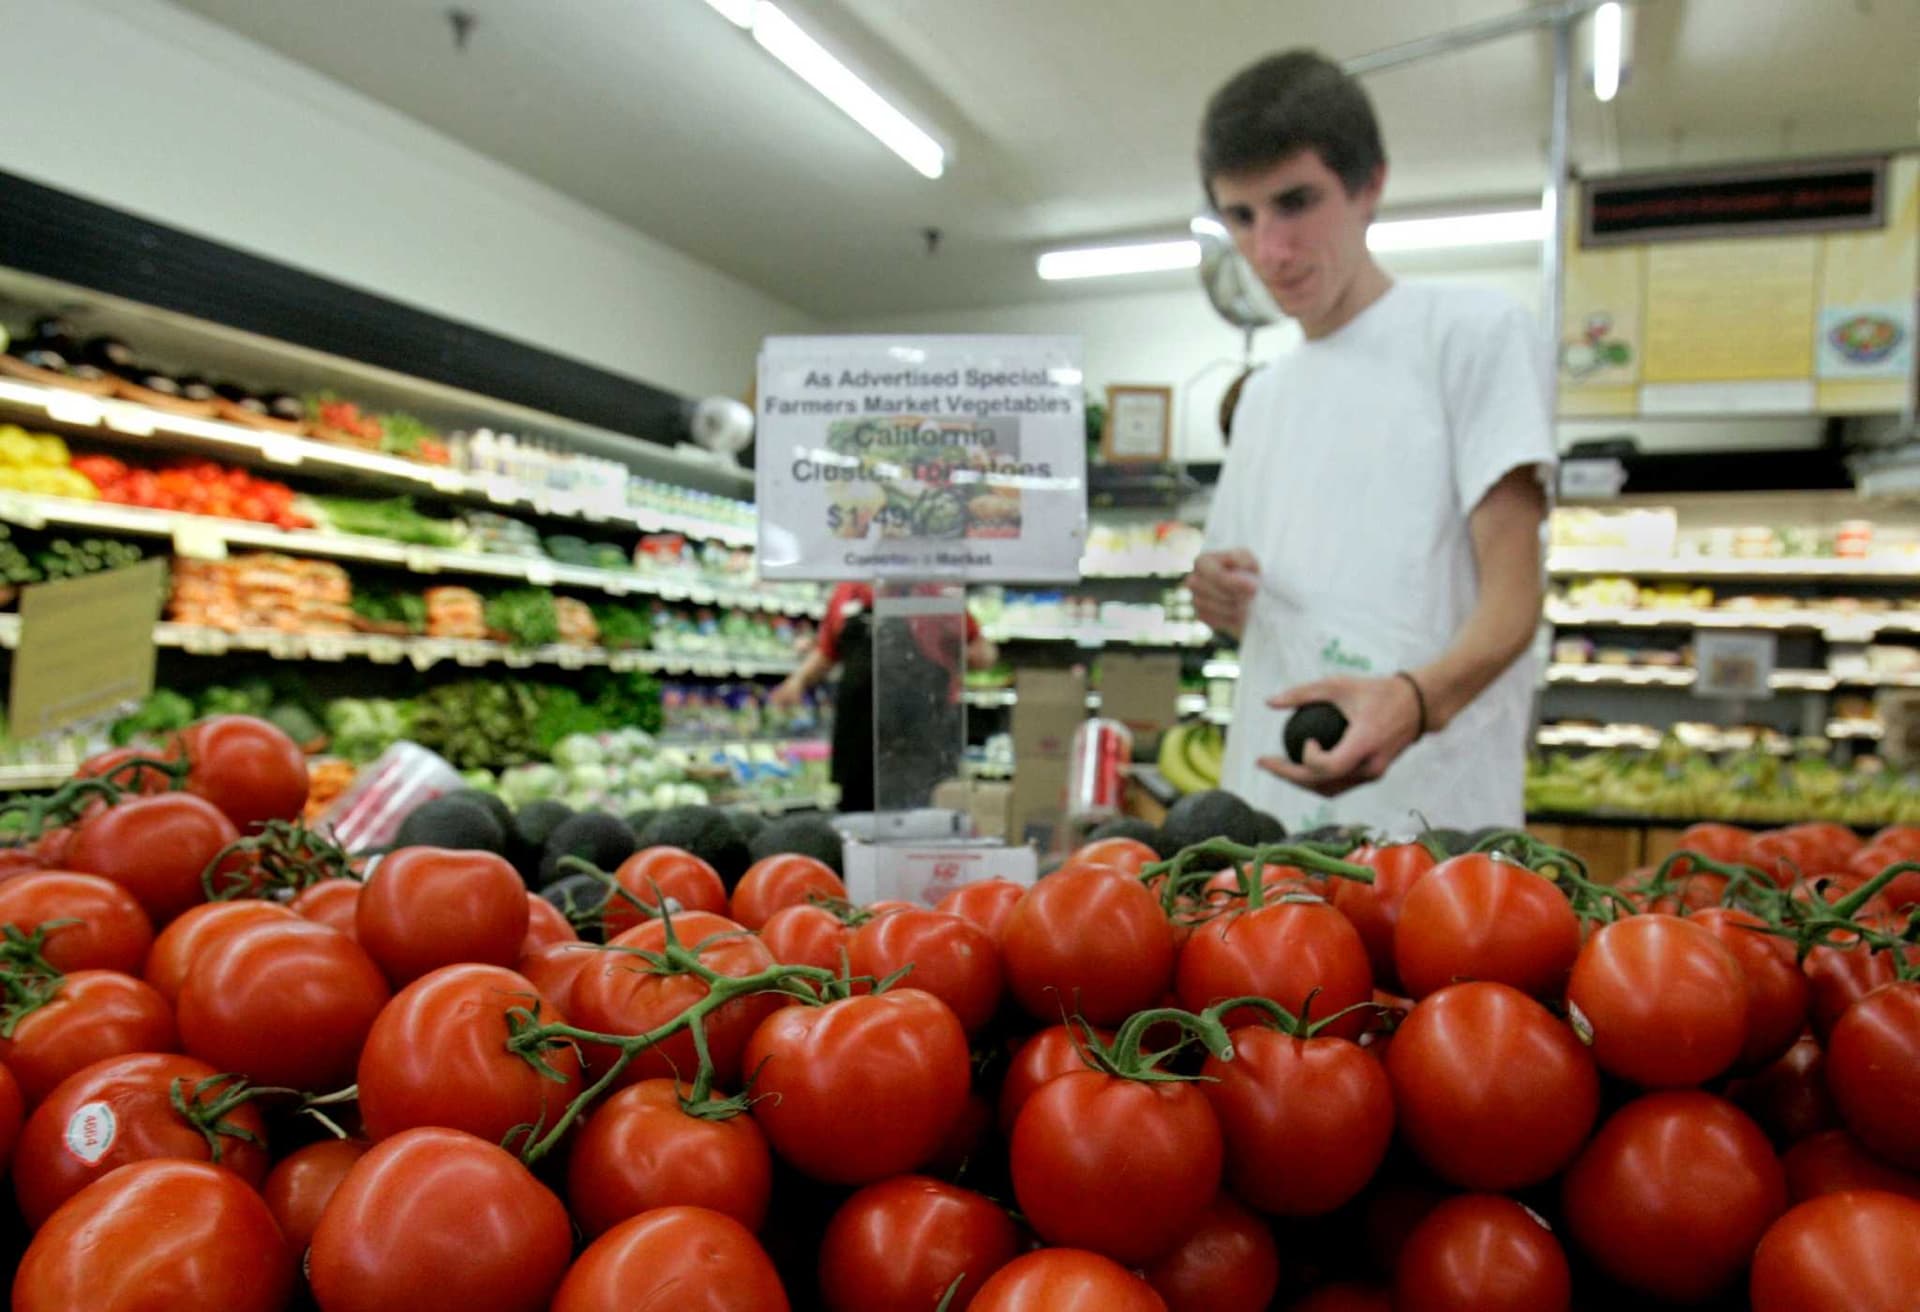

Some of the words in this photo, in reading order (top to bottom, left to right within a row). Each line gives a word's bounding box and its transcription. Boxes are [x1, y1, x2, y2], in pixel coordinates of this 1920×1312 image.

[805, 371, 832, 387] As
[838, 369, 958, 387] Advertised
[965, 368, 1060, 390] Special
[765, 396, 857, 414] Farmers
[864, 396, 940, 412] Market
[946, 395, 1071, 417] Vegetables
[855, 422, 997, 447] California
[936, 552, 992, 566] Market
